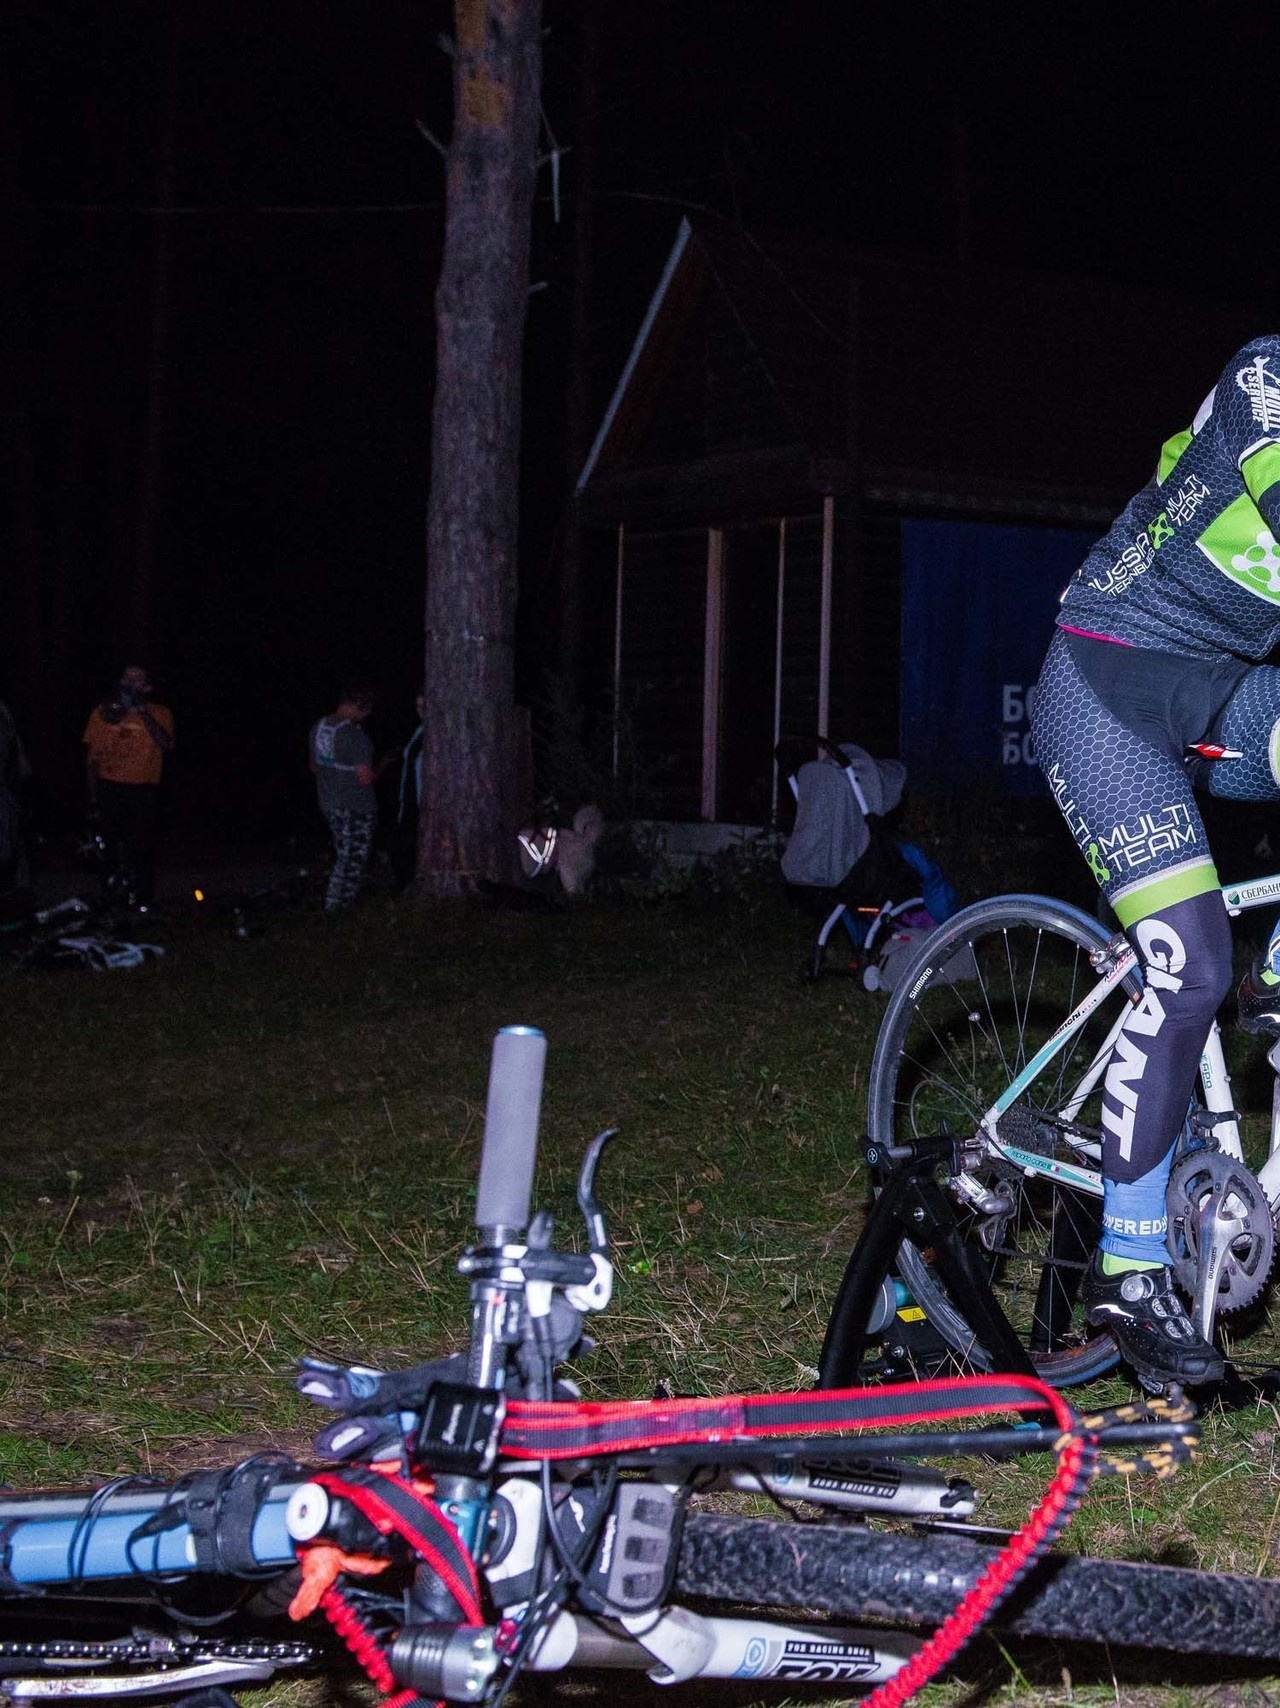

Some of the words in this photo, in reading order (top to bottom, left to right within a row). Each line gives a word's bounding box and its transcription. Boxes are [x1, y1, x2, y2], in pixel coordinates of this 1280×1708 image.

[1247, 375, 1265, 423] SERVICE
[1165, 474, 1203, 519] MULTI
[1171, 484, 1211, 526] TEAM
[1049, 763, 1092, 846] MULTI
[1098, 803, 1190, 856] MULTI
[1107, 824, 1197, 872] TEAM
[909, 967, 933, 1000] SHIMANO
[1102, 919, 1187, 1163] GIANT
[1208, 1247, 1217, 1280] SHIMANO
